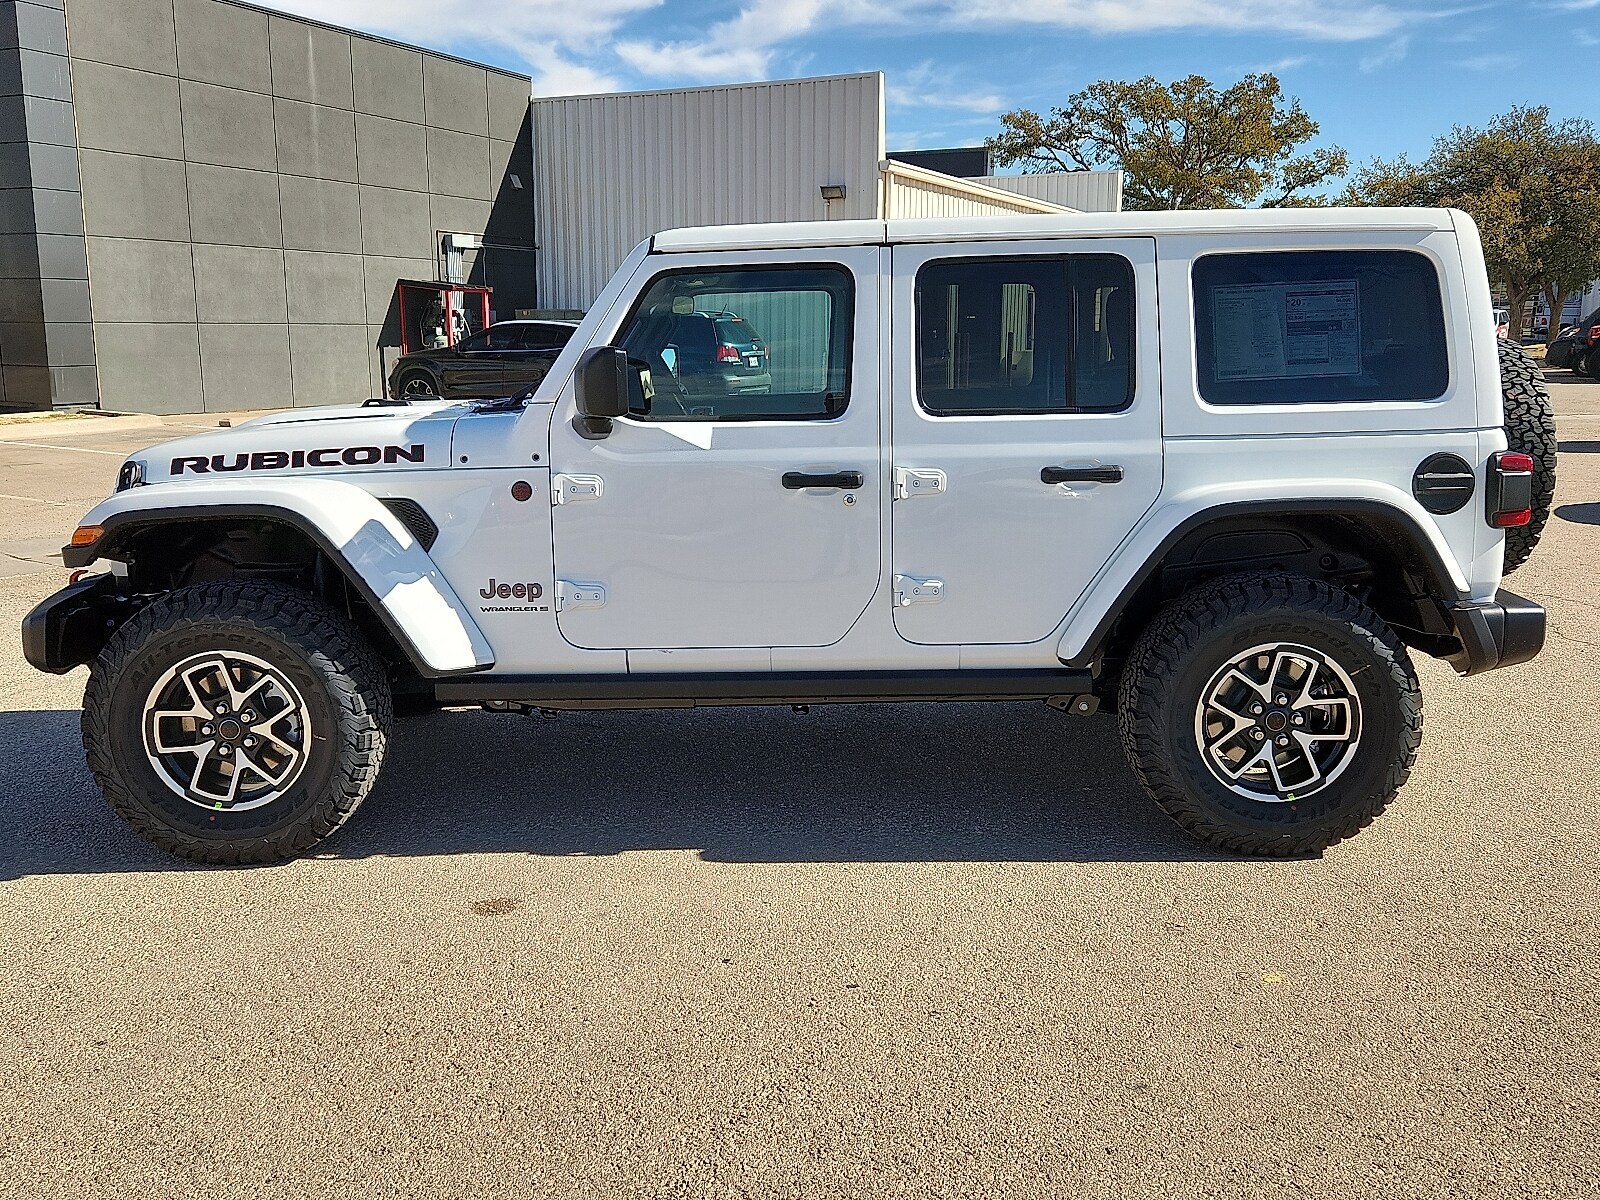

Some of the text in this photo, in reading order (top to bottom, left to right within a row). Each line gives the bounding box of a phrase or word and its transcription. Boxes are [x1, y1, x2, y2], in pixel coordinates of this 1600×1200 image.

[1290, 298, 1302, 307] 20
[170, 443, 425, 476] RUBICON
[479, 578, 543, 603] Jeep
[131, 632, 272, 690] All-Terrain
